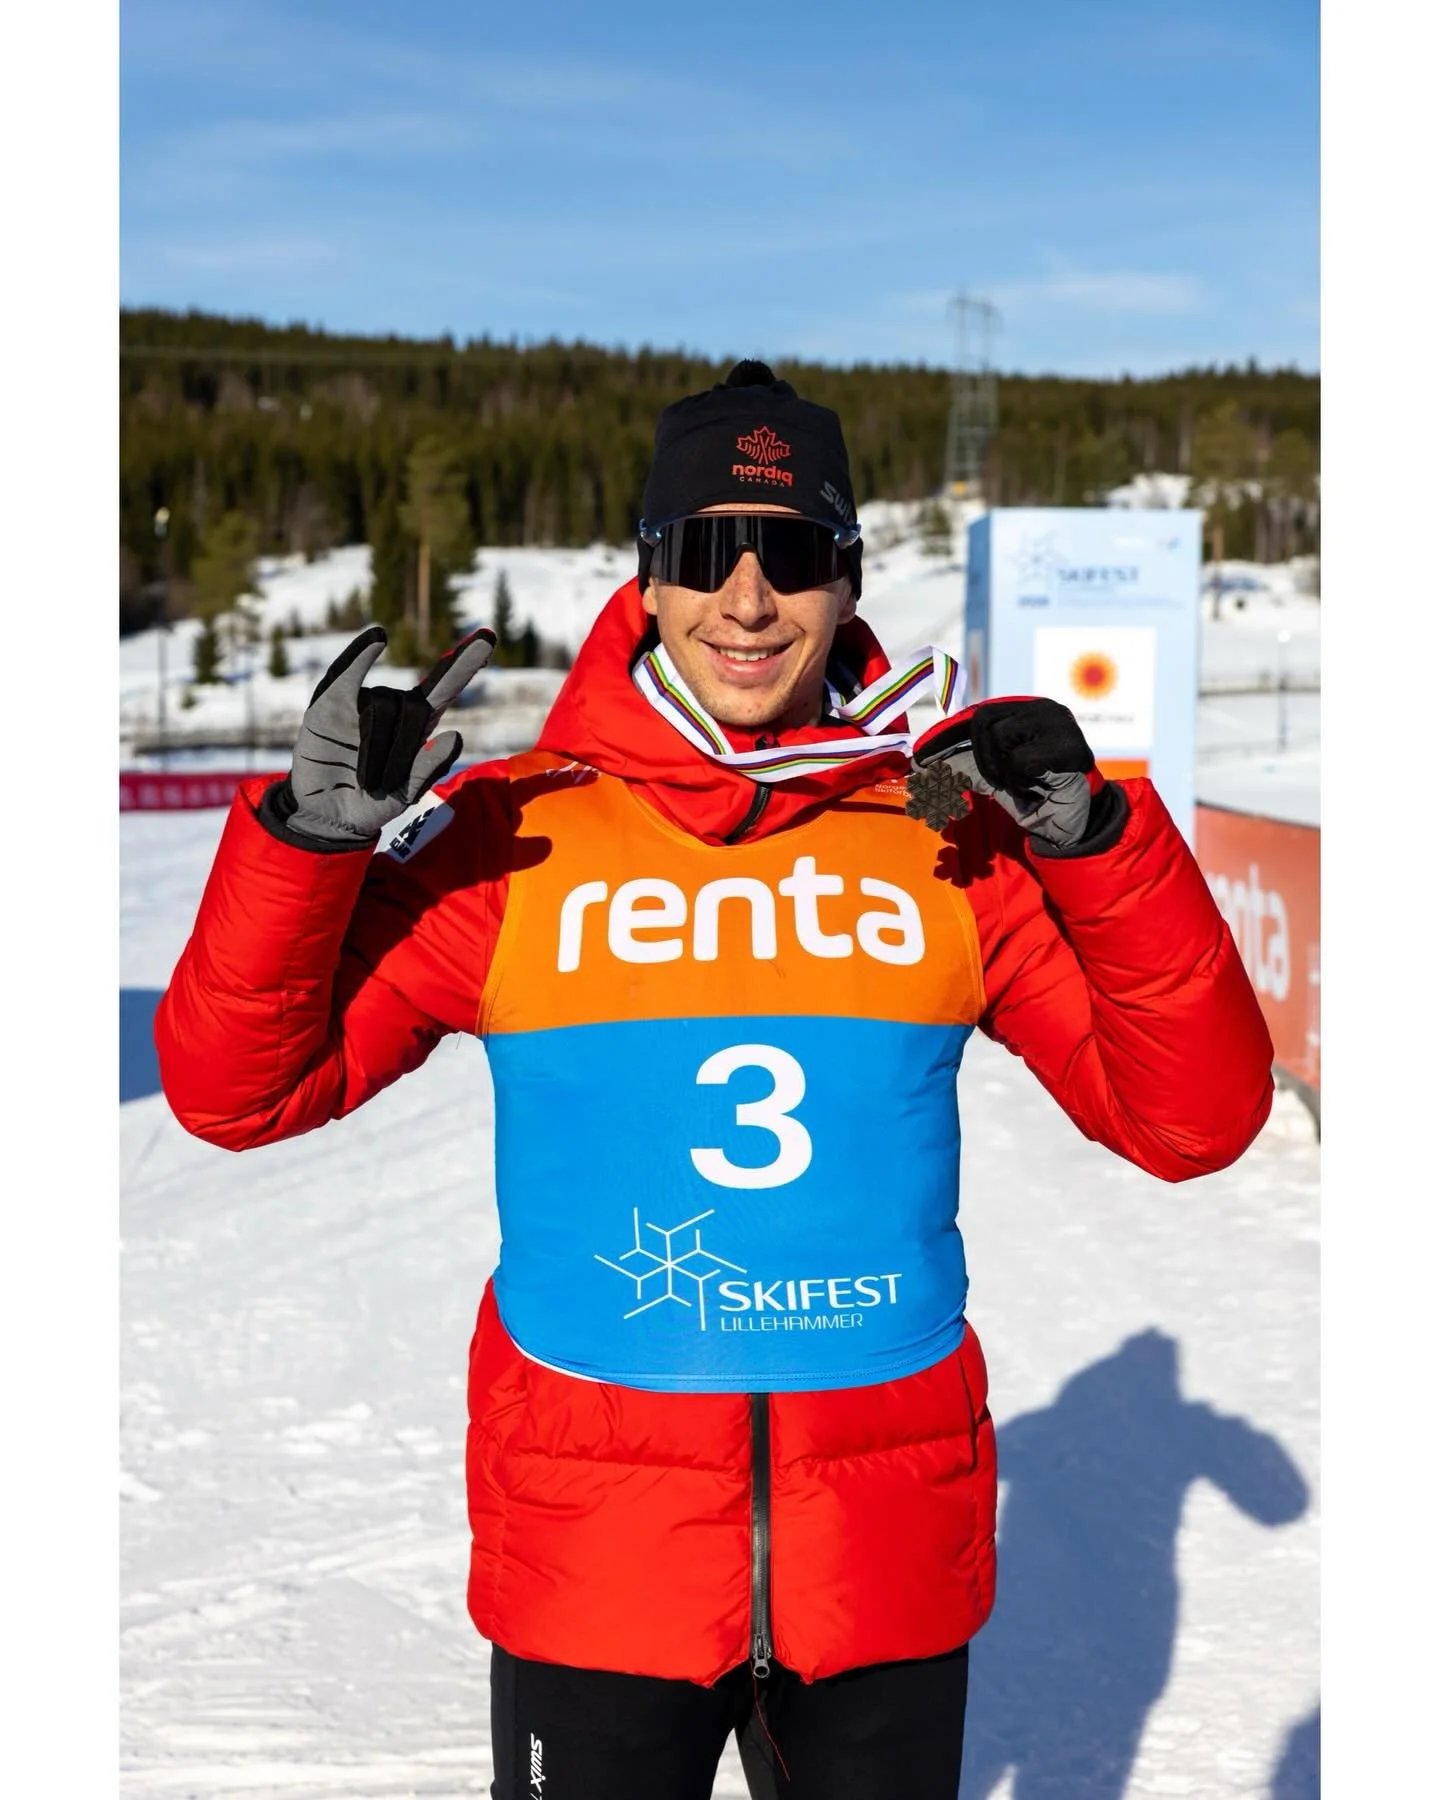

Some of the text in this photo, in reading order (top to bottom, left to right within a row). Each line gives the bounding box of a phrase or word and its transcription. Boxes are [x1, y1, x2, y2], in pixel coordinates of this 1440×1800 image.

[739, 476, 786, 488] CANADA
[557, 855, 926, 973] renta
[690, 1044, 813, 1190] 3
[718, 1272, 903, 1313] SKIFEST
[720, 1312, 863, 1332] LILLEHAMMER
